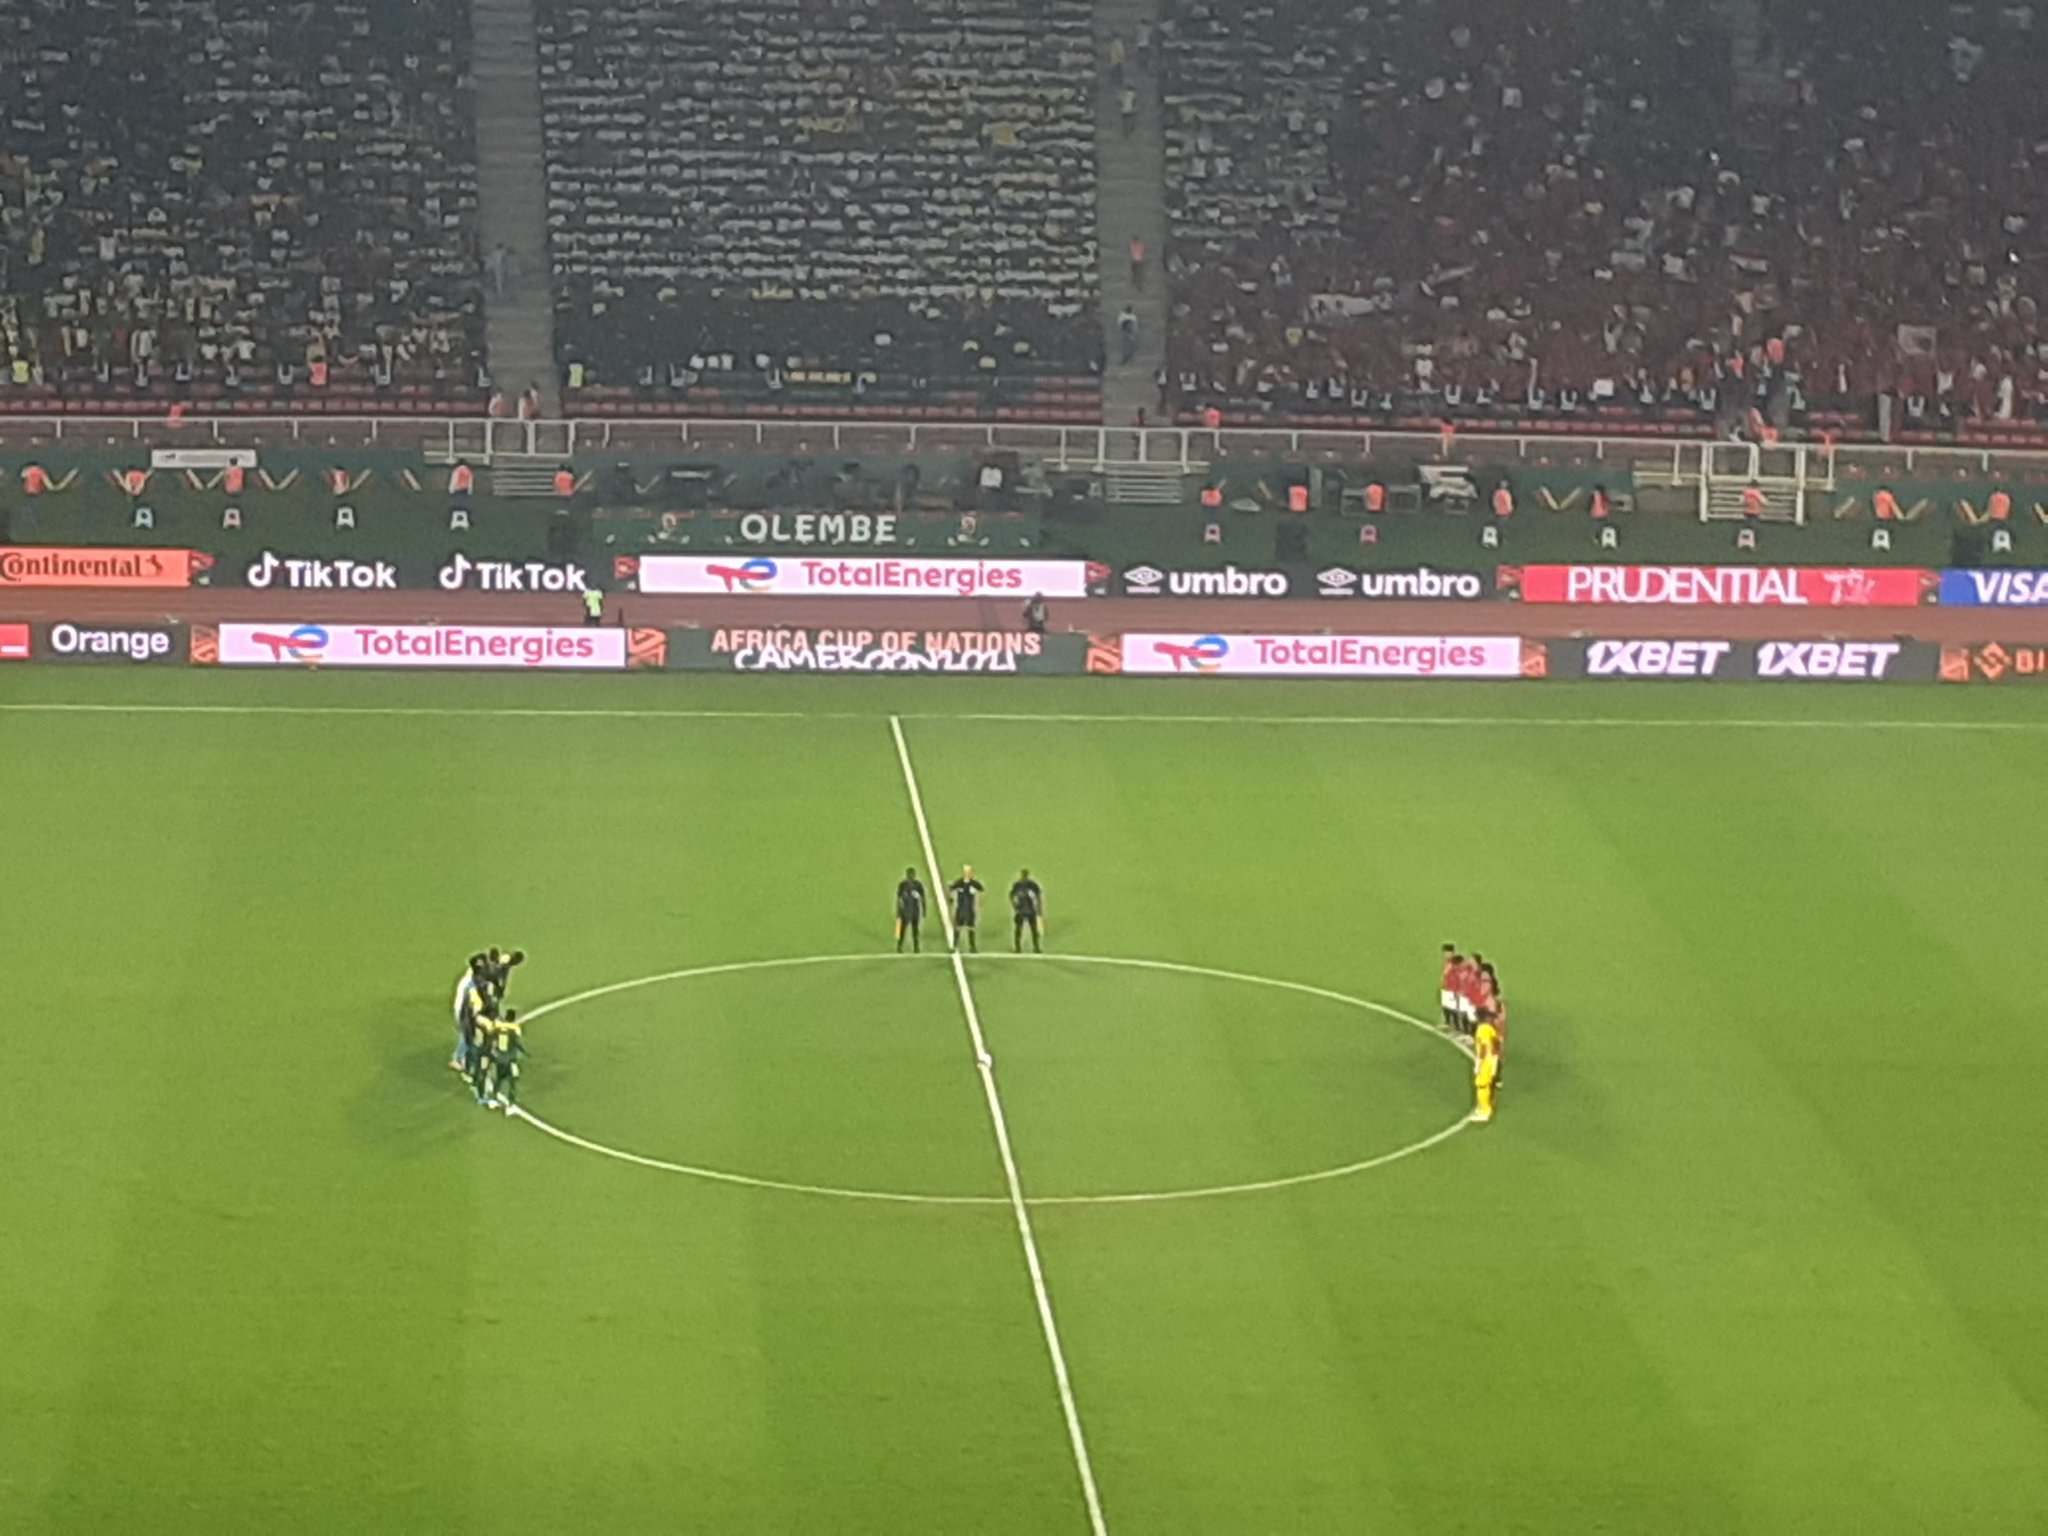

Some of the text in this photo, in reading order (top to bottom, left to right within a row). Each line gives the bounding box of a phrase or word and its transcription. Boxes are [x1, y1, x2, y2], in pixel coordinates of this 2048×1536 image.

[741, 514, 897, 543] OLEMBE
[0, 552, 142, 582] Continental
[285, 560, 397, 588] TikTok
[476, 562, 588, 590] TikTok
[801, 561, 1022, 596] TotalEnergies
[1169, 565, 1288, 596] umbro
[1362, 567, 1481, 597] umbro
[1567, 566, 1808, 604] PRUDENTIAL
[51, 623, 170, 659] Orange
[355, 629, 594, 663] TotalEnergies
[711, 629, 1041, 655] AFRICA CUP OF NATIONS
[1253, 638, 1485, 673] TotalEnergies
[1586, 641, 1731, 675] 1XBET
[1757, 642, 1901, 677] 1XBET
